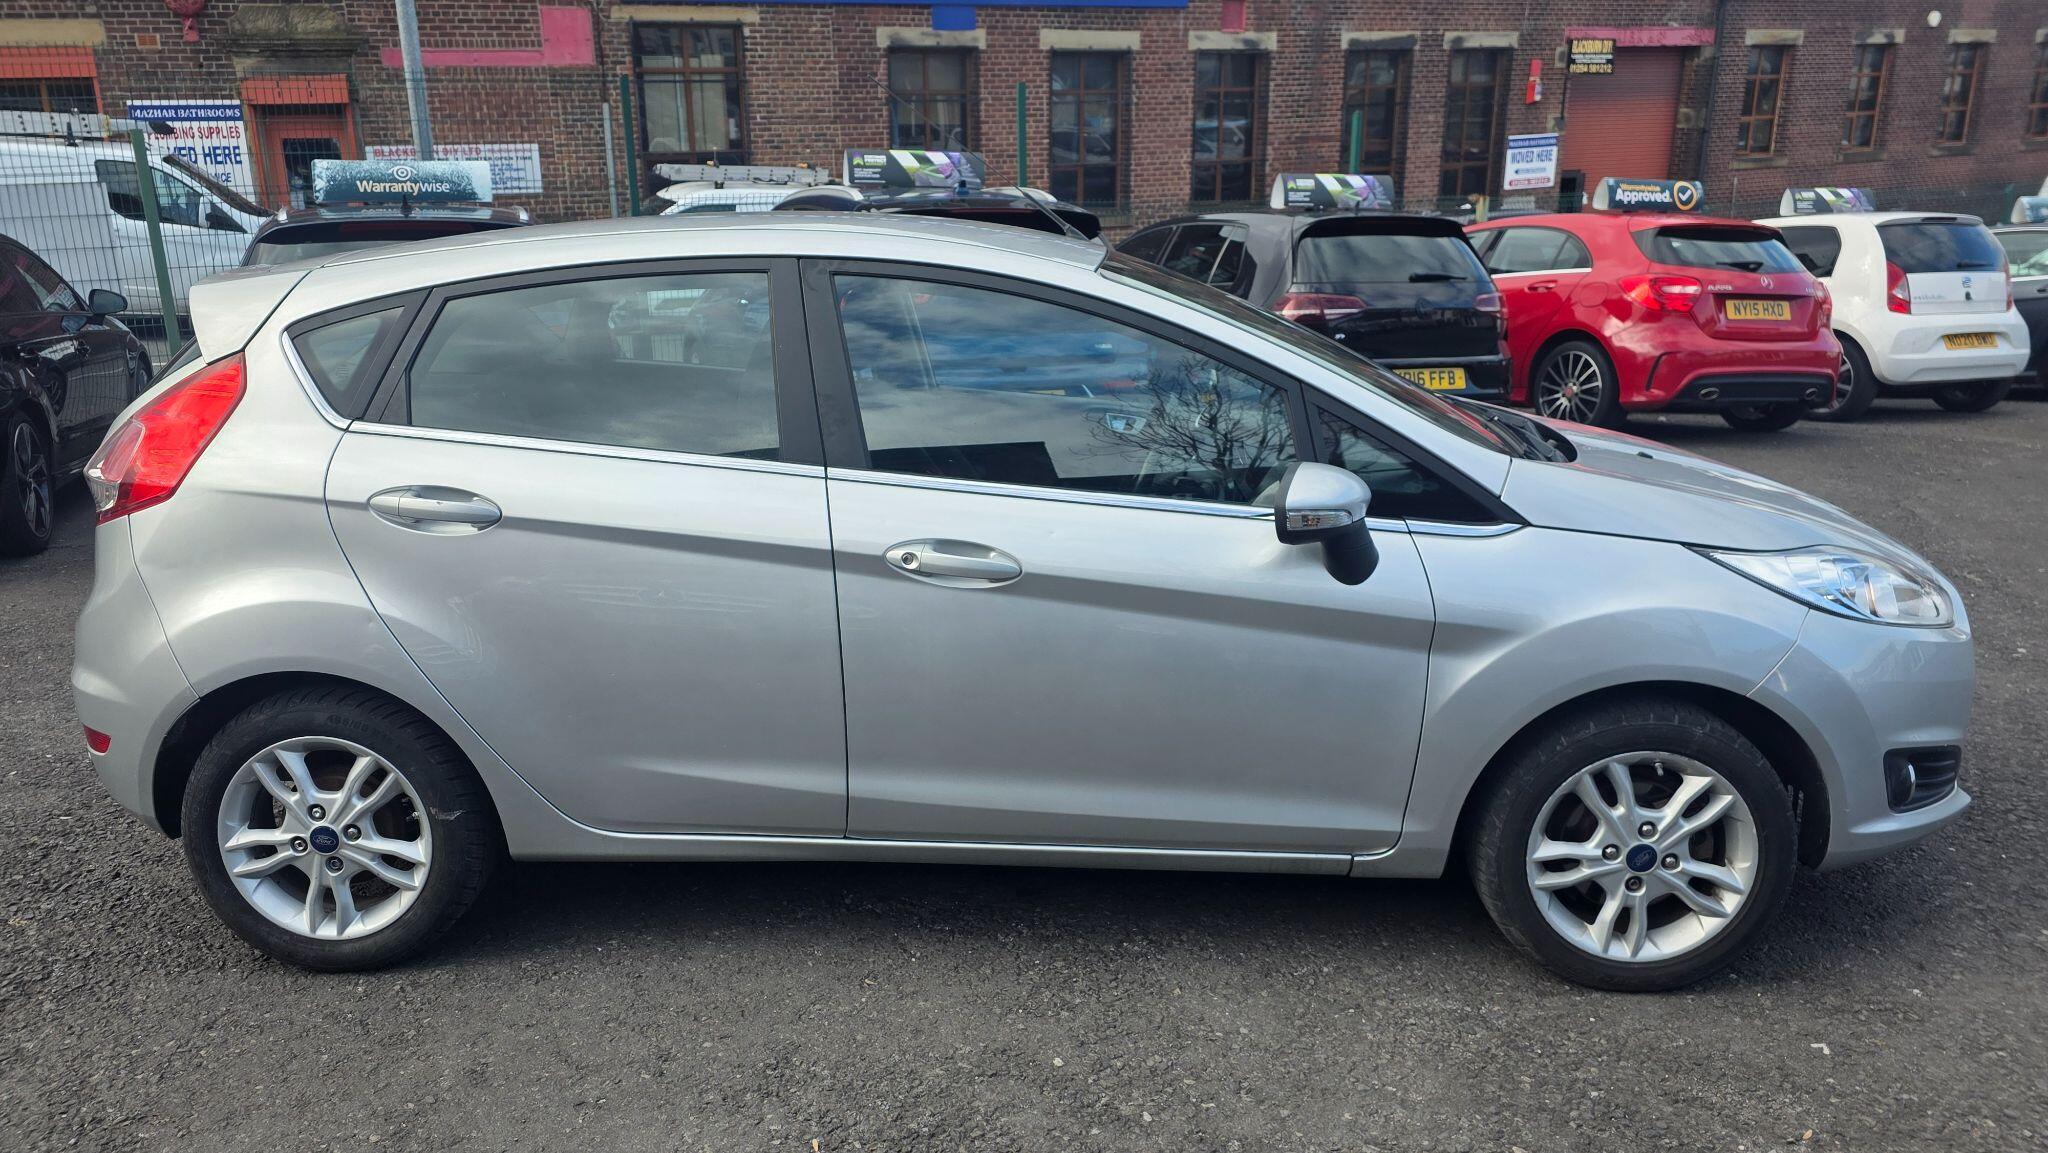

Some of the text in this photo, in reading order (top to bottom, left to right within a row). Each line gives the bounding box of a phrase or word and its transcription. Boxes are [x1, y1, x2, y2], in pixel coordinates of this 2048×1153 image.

[131, 108, 240, 119] MAZHAR BATHROOMS
[198, 126, 240, 139] SUPPLIES
[202, 145, 242, 165] HERE
[374, 147, 439, 157] BLACKBN
[463, 146, 482, 156] LTD
[356, 180, 450, 196] Warrantywise
[1733, 302, 1784, 317] NY15 HXD
[1429, 370, 1456, 386] FFB
